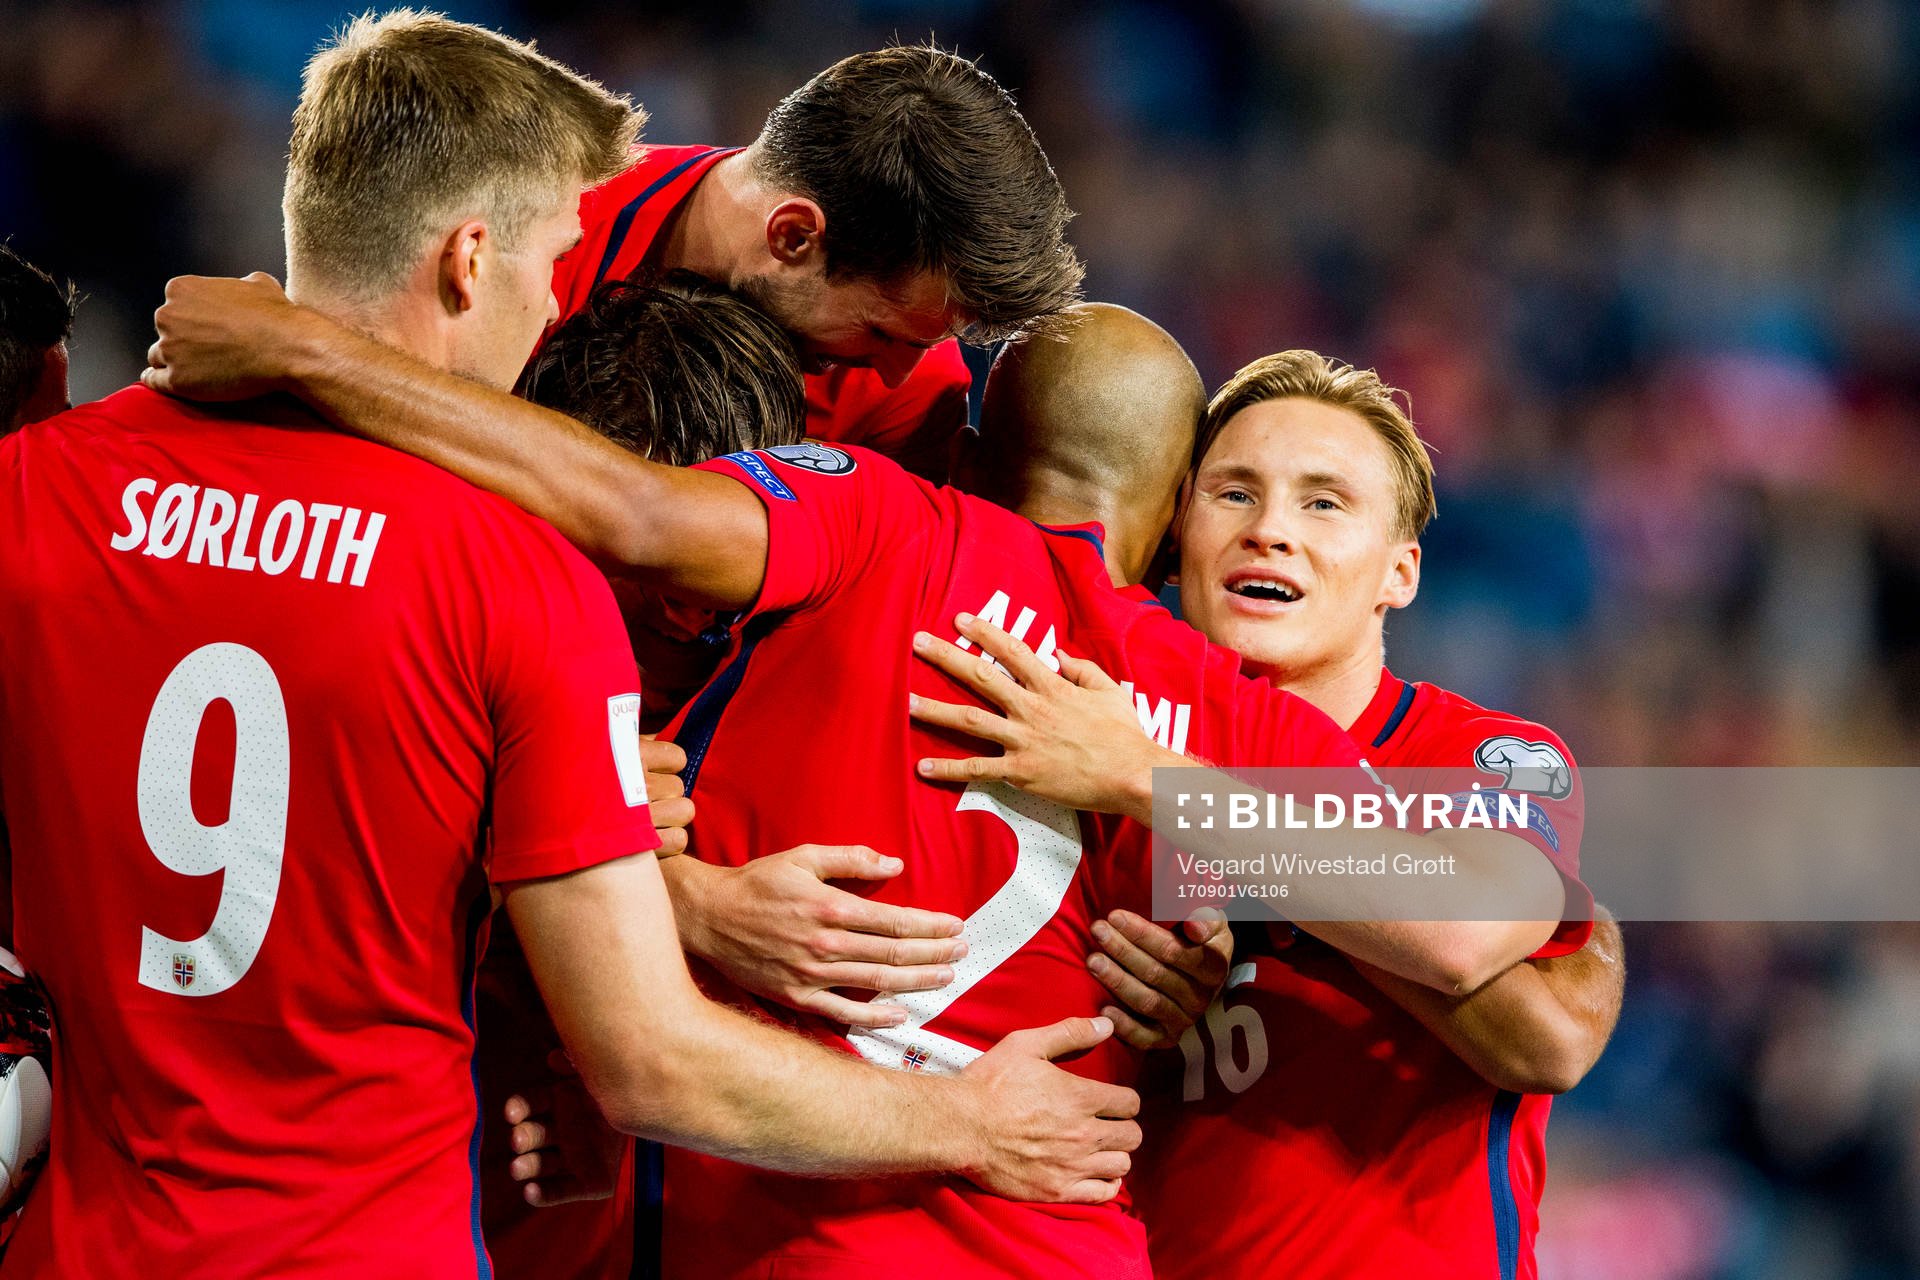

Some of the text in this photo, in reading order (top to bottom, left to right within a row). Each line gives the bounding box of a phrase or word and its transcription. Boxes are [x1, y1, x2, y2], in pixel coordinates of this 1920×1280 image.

[110, 477, 387, 588] SØRLOTH
[136, 641, 291, 997] 9
[846, 779, 1083, 1075] 2
